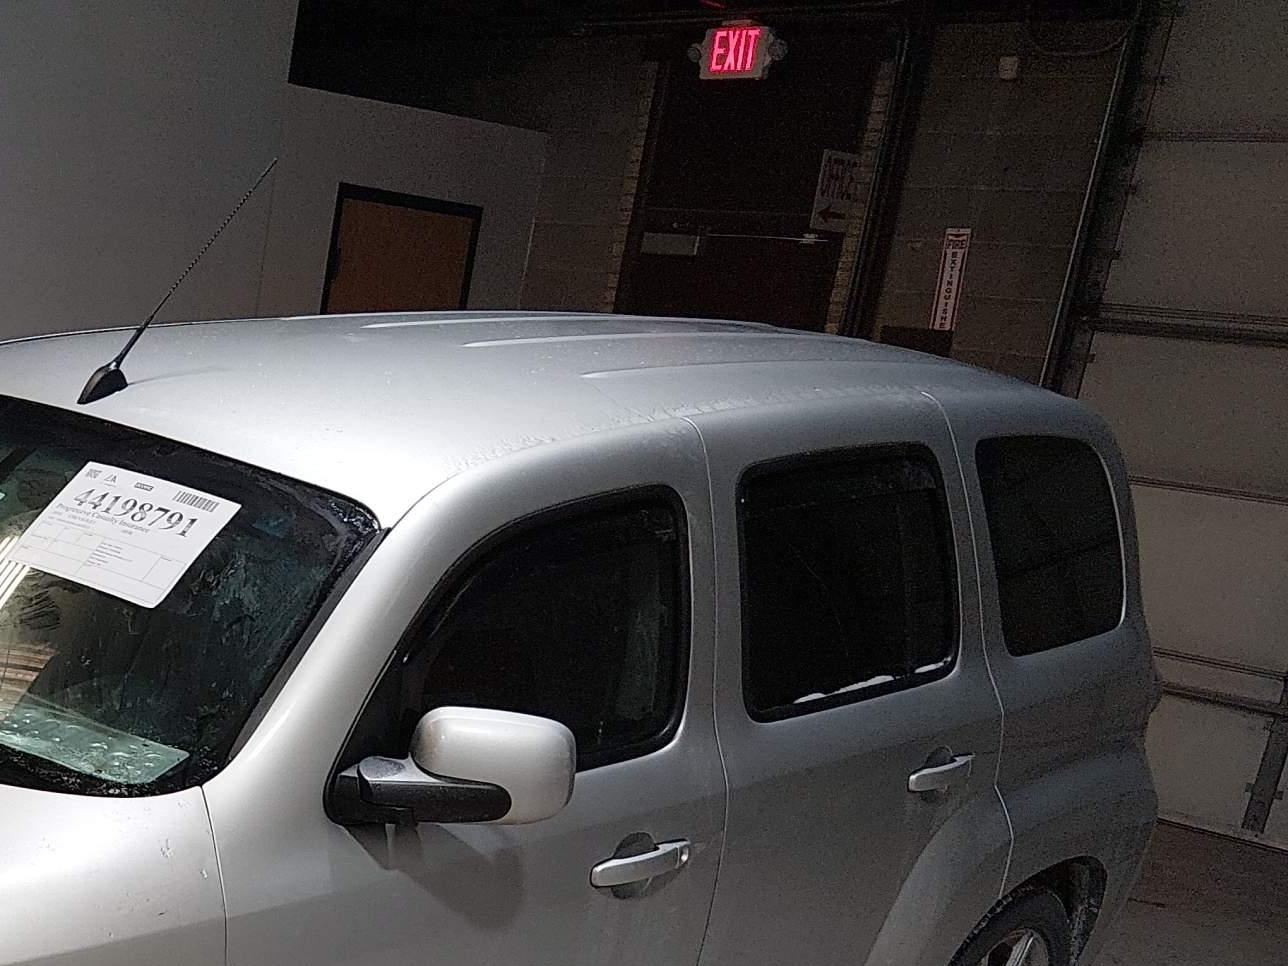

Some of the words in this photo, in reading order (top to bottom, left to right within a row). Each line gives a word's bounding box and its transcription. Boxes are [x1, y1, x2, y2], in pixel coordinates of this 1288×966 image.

[710, 29, 760, 71] EXIT
[946, 239, 967, 249] FIRE
[939, 251, 959, 329] EXTINGUISHE
[73, 488, 198, 537] 44198791
